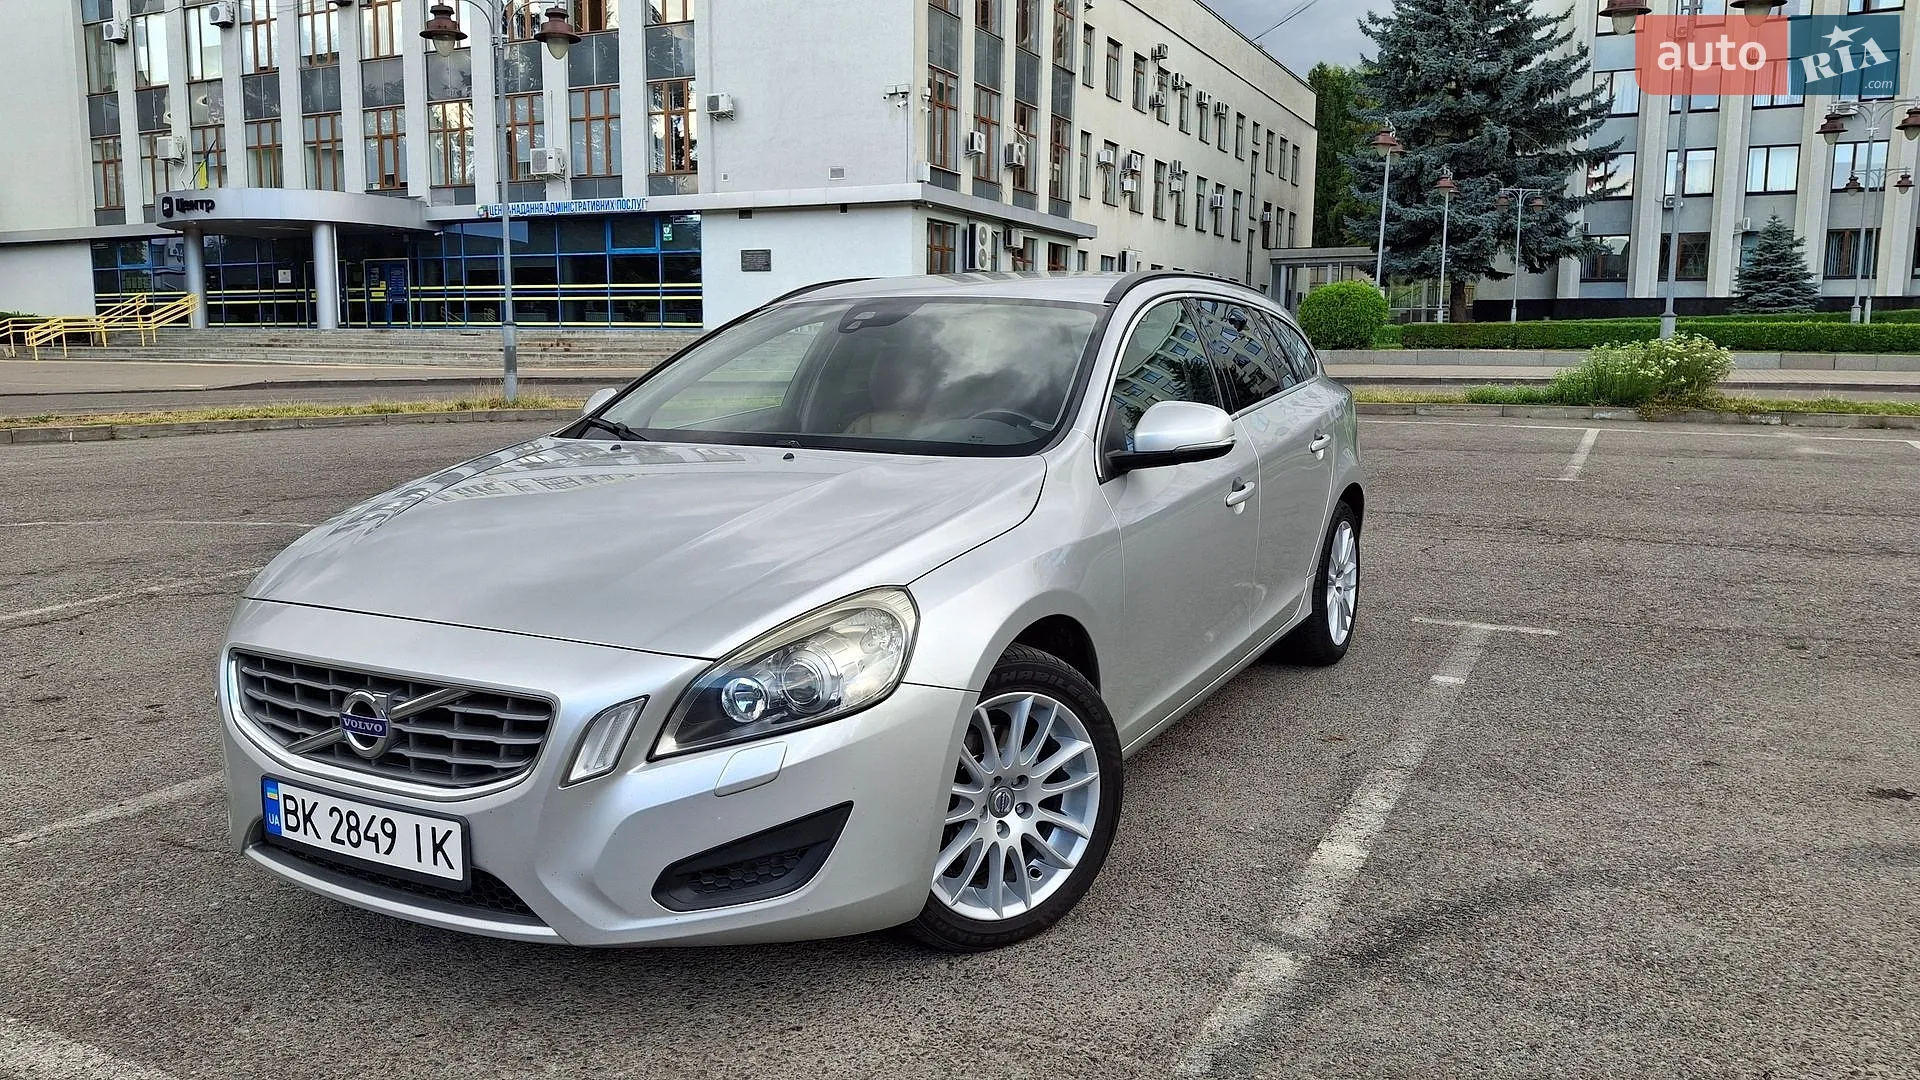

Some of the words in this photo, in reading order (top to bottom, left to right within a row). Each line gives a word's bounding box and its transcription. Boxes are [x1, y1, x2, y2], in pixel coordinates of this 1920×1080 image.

[175, 198, 216, 213] Центр
[489, 204, 511, 216] ЦЕН
[512, 203, 544, 214] НАДАННЯ
[545, 200, 617, 214] АДМІНІСТРАТИВНИХ
[617, 198, 647, 211] ПОСЛУГ
[343, 717, 383, 733] VOLVO
[268, 813, 281, 827] UA
[282, 793, 322, 841] BK
[328, 806, 398, 856] 2849
[415, 823, 456, 871] IK
